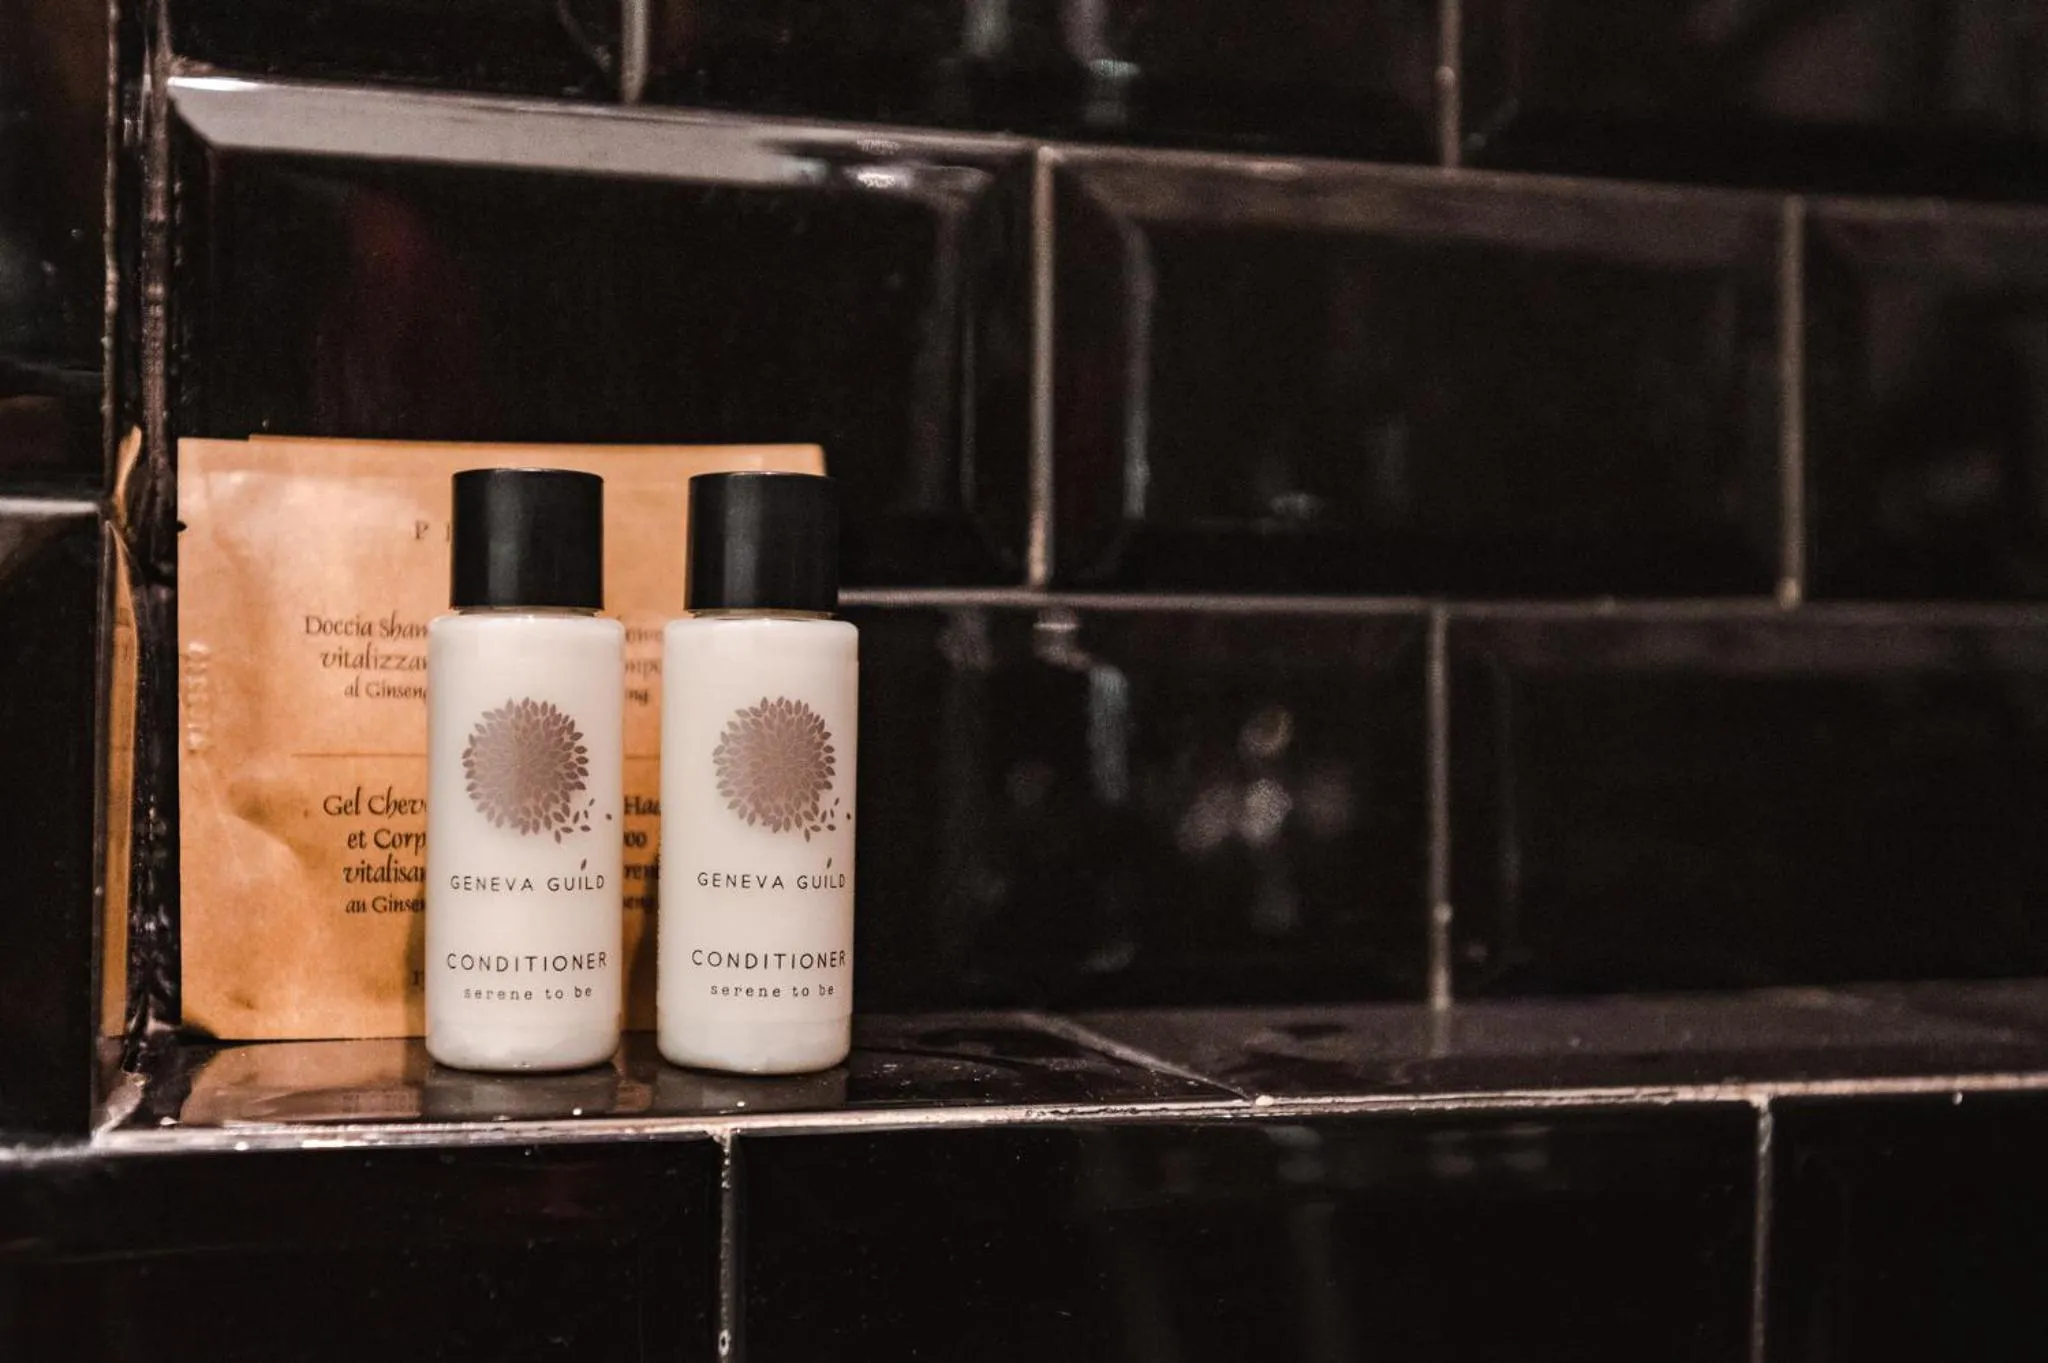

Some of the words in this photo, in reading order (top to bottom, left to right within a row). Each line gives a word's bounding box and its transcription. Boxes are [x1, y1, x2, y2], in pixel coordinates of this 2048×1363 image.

[305, 612, 372, 636] Doccia
[344, 676, 360, 698] al
[323, 786, 361, 816] Gel
[368, 786, 427, 819] Chev
[347, 829, 367, 849] et
[373, 828, 426, 856] Corp
[450, 875, 534, 892] GENEVA
[547, 875, 605, 892] GUILD
[697, 872, 785, 889] GENEVA
[796, 873, 845, 889] GUILD
[345, 899, 367, 913] au
[447, 952, 607, 972] CONDITIONER
[691, 949, 846, 970] CONDITIONER
[464, 988, 533, 1000] serene
[545, 987, 564, 999] to
[574, 986, 592, 998] be
[710, 984, 781, 998] serene
[792, 985, 810, 997] to
[818, 984, 834, 995] be
